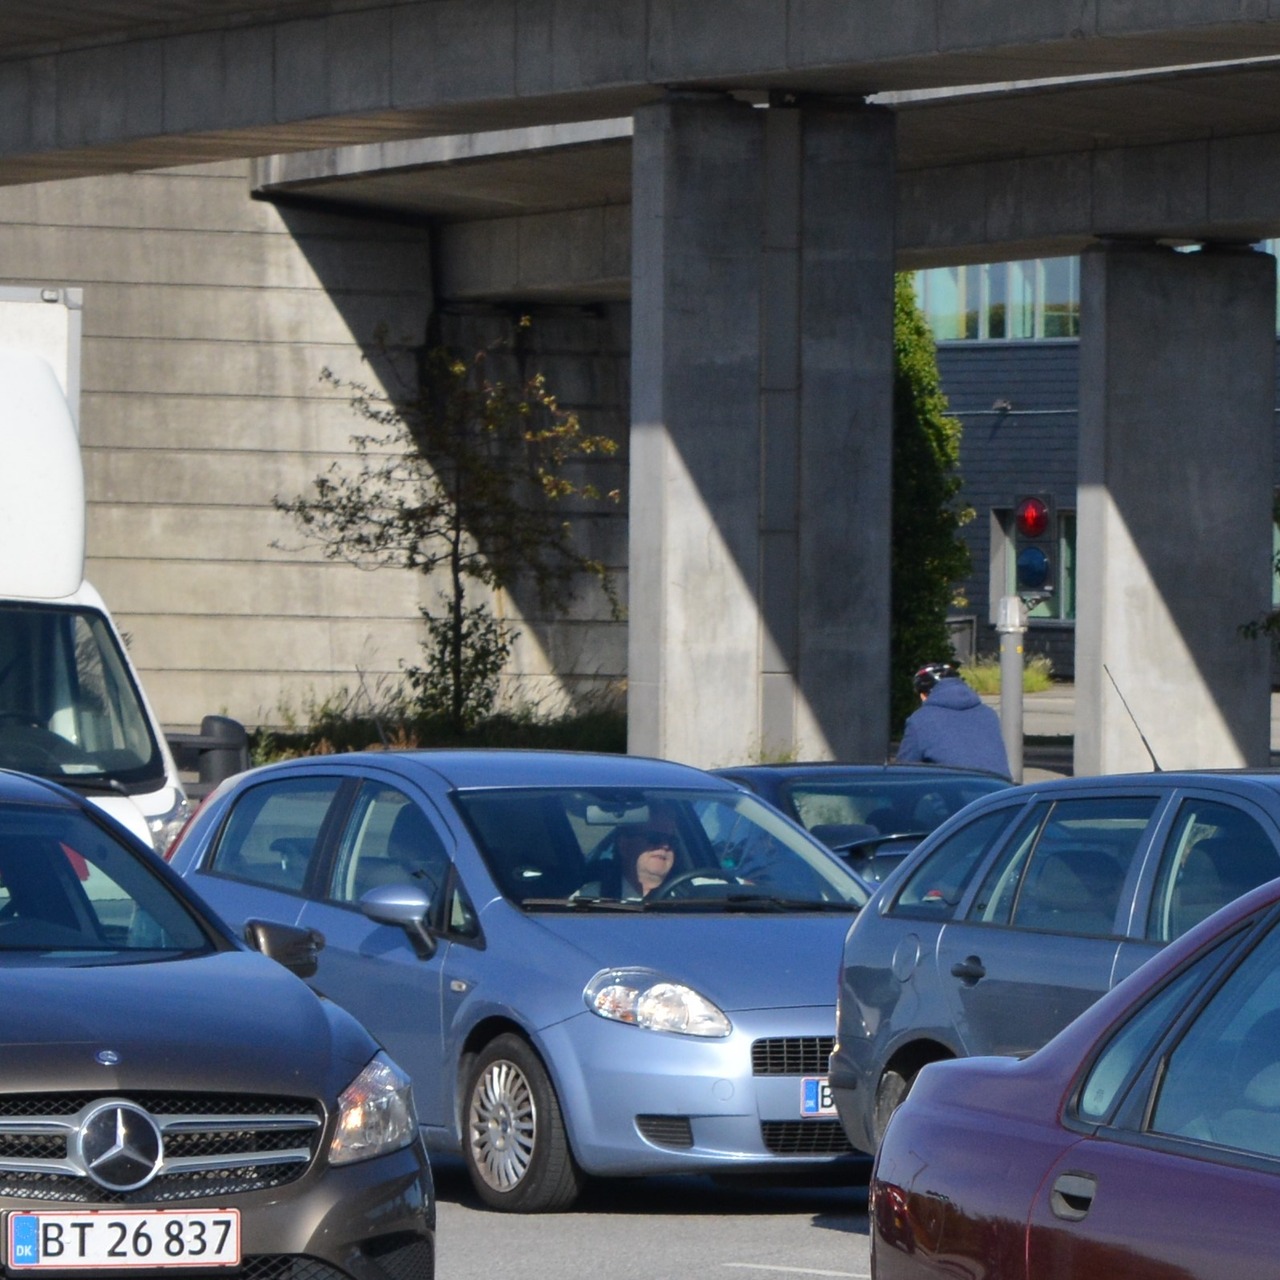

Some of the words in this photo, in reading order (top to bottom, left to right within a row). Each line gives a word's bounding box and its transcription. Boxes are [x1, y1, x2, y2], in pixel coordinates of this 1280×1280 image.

[16, 1245, 32, 1256] DK
[42, 1223, 94, 1257] BT
[107, 1221, 152, 1257] 26
[164, 1220, 231, 1257] 837
